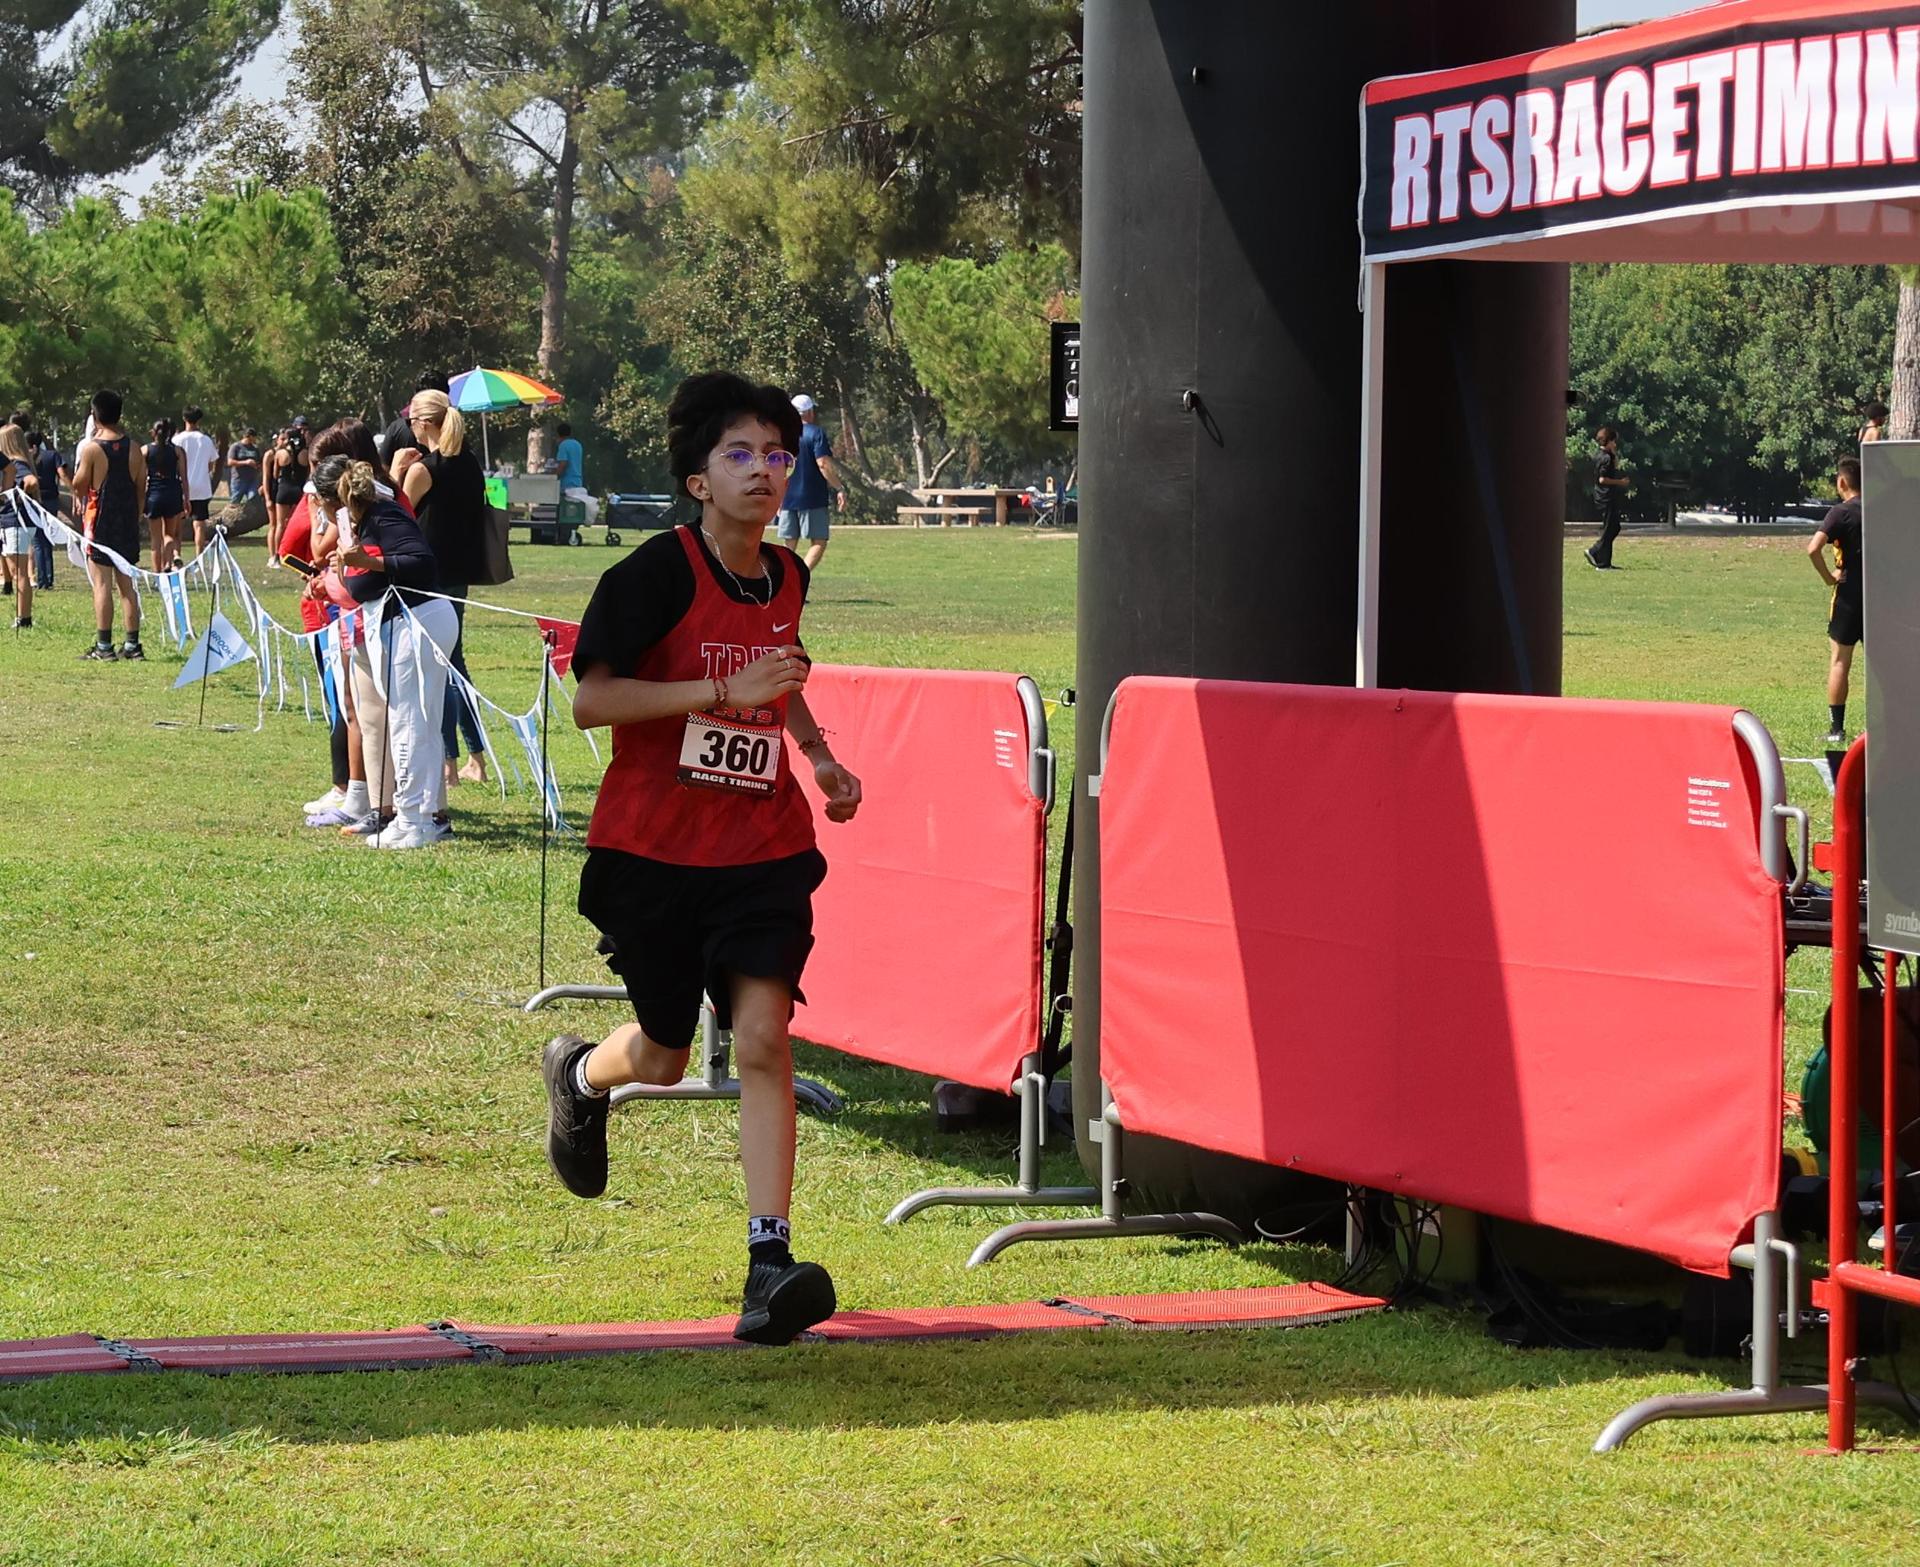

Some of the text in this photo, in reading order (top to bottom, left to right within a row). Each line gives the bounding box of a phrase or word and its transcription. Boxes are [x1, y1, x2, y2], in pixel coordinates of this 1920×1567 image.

[699, 730, 769, 776] 360
[691, 771, 768, 791] RACE TIMING
[1885, 911, 1920, 932] symb
